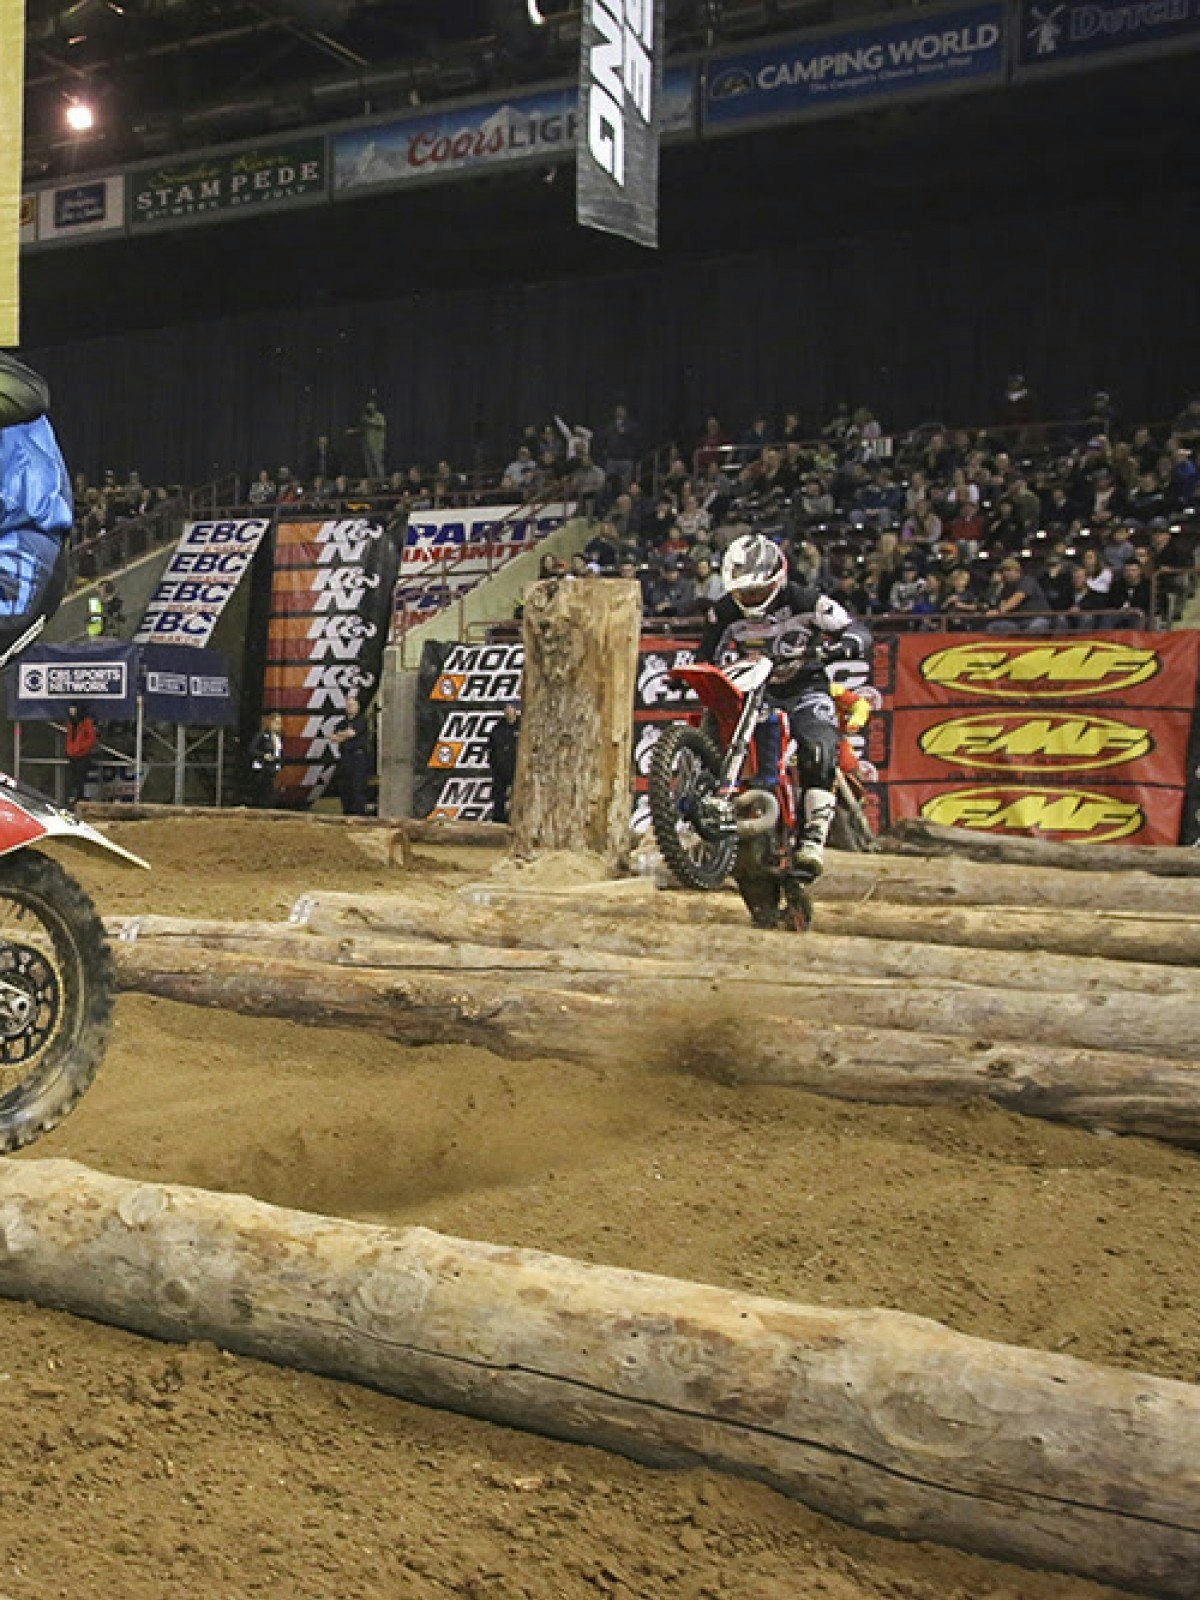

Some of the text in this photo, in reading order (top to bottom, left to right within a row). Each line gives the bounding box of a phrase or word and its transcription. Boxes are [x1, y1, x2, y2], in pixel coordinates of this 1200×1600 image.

[757, 45, 884, 90] CAMPING
[888, 23, 1000, 64] WORLD
[406, 112, 581, 167] Coors LIGH
[136, 160, 319, 210] STAMPEDE
[186, 521, 264, 544] EBC
[315, 520, 384, 562] K&N
[407, 517, 567, 546] PARTS
[169, 552, 250, 573] EBC
[151, 582, 231, 603] EBC
[311, 567, 380, 610] K&N
[139, 612, 213, 635] EBC
[307, 616, 378, 659] K&N
[50, 668, 121, 681] CBS SPORTS
[925, 645, 1156, 681] FMF
[50, 681, 109, 692] NETWORK
[923, 719, 1148, 756] FMF
[922, 796, 1141, 831] FMF
